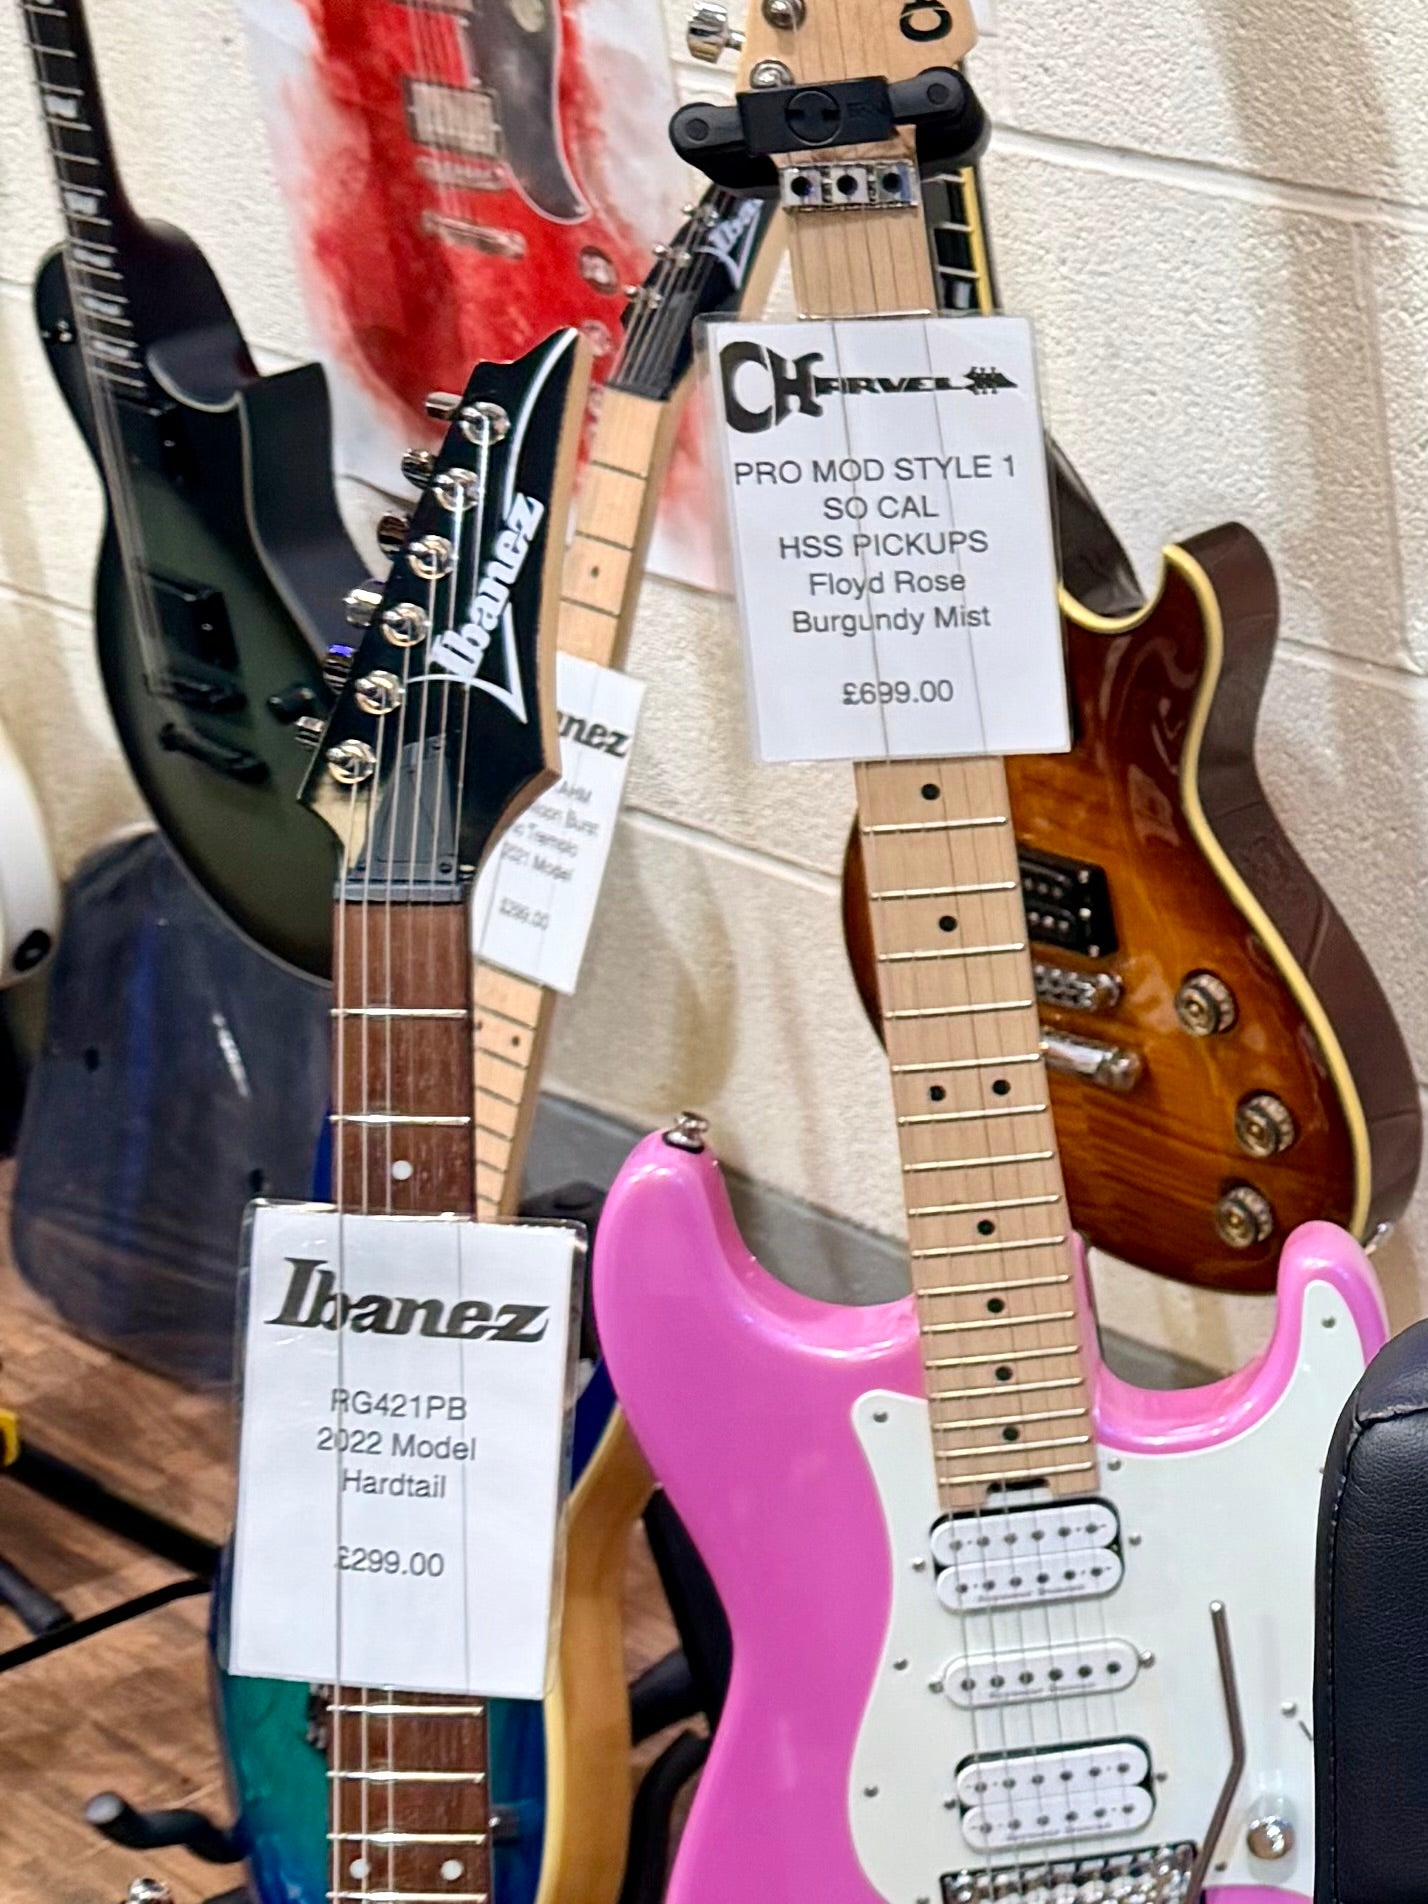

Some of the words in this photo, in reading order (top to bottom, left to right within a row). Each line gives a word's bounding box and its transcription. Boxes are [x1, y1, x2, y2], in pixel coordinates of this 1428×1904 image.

[734, 459, 801, 486] PRO
[812, 457, 884, 483] MOD
[894, 454, 993, 481] STYLE
[1003, 454, 1016, 478] 1
[823, 497, 868, 521] SO
[877, 494, 940, 520] CAL
[778, 534, 844, 560] HSS
[852, 529, 990, 558] PICKUPS
[431, 492, 545, 678] Ibanez
[808, 570, 885, 601] Floyd
[894, 570, 967, 594] Rose
[792, 608, 925, 637] Burgundy
[934, 604, 992, 629] Mist
[842, 679, 955, 706] £699.00
[557, 709, 631, 759] nez
[264, 1256, 550, 1344] Ibanez
[330, 1388, 468, 1422] RG421PB
[316, 1426, 382, 1457] 2022
[390, 1431, 477, 1462] Model
[340, 1469, 447, 1500] Hardtail
[335, 1545, 444, 1578] £299.00
